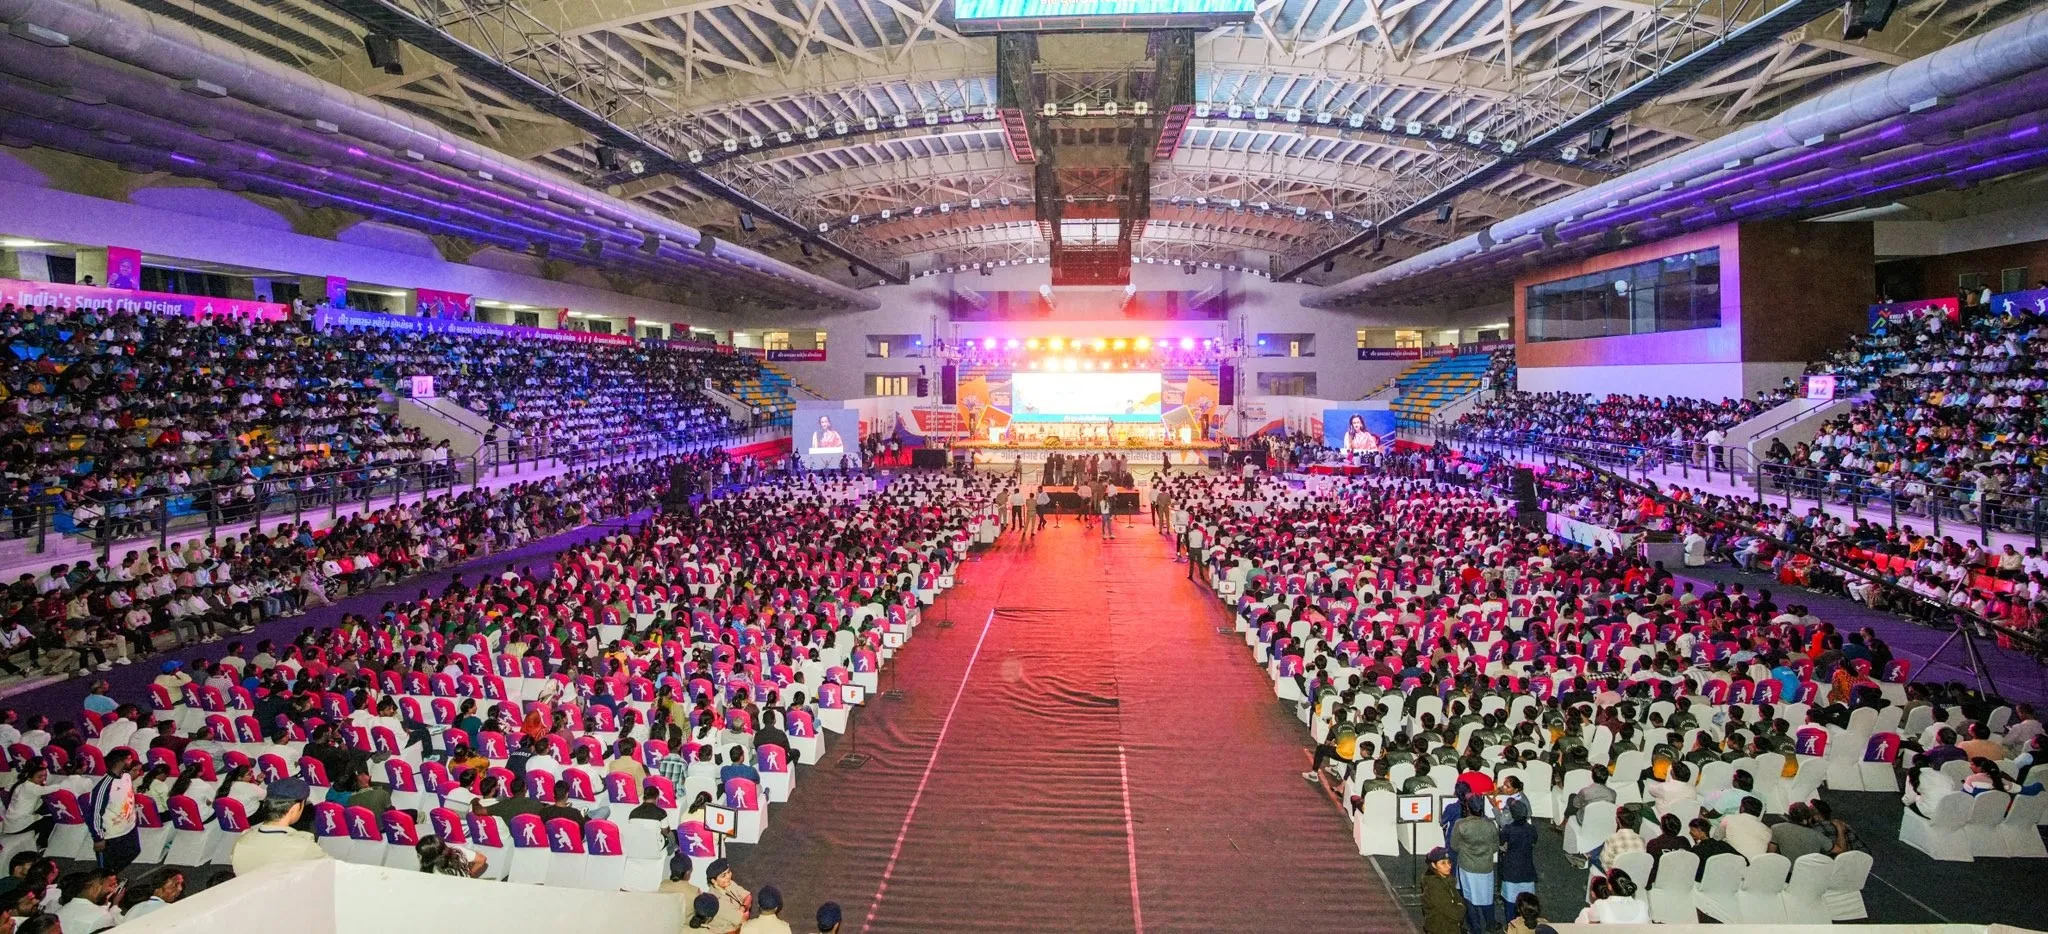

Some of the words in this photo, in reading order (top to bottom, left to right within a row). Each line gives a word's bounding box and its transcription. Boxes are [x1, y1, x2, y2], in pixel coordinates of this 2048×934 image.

[18, 291, 72, 309] India's
[75, 295, 113, 312] Sport
[891, 636, 896, 644] E
[850, 690, 857, 699] F
[1411, 802, 1419, 814] E
[716, 813, 725, 825] D
